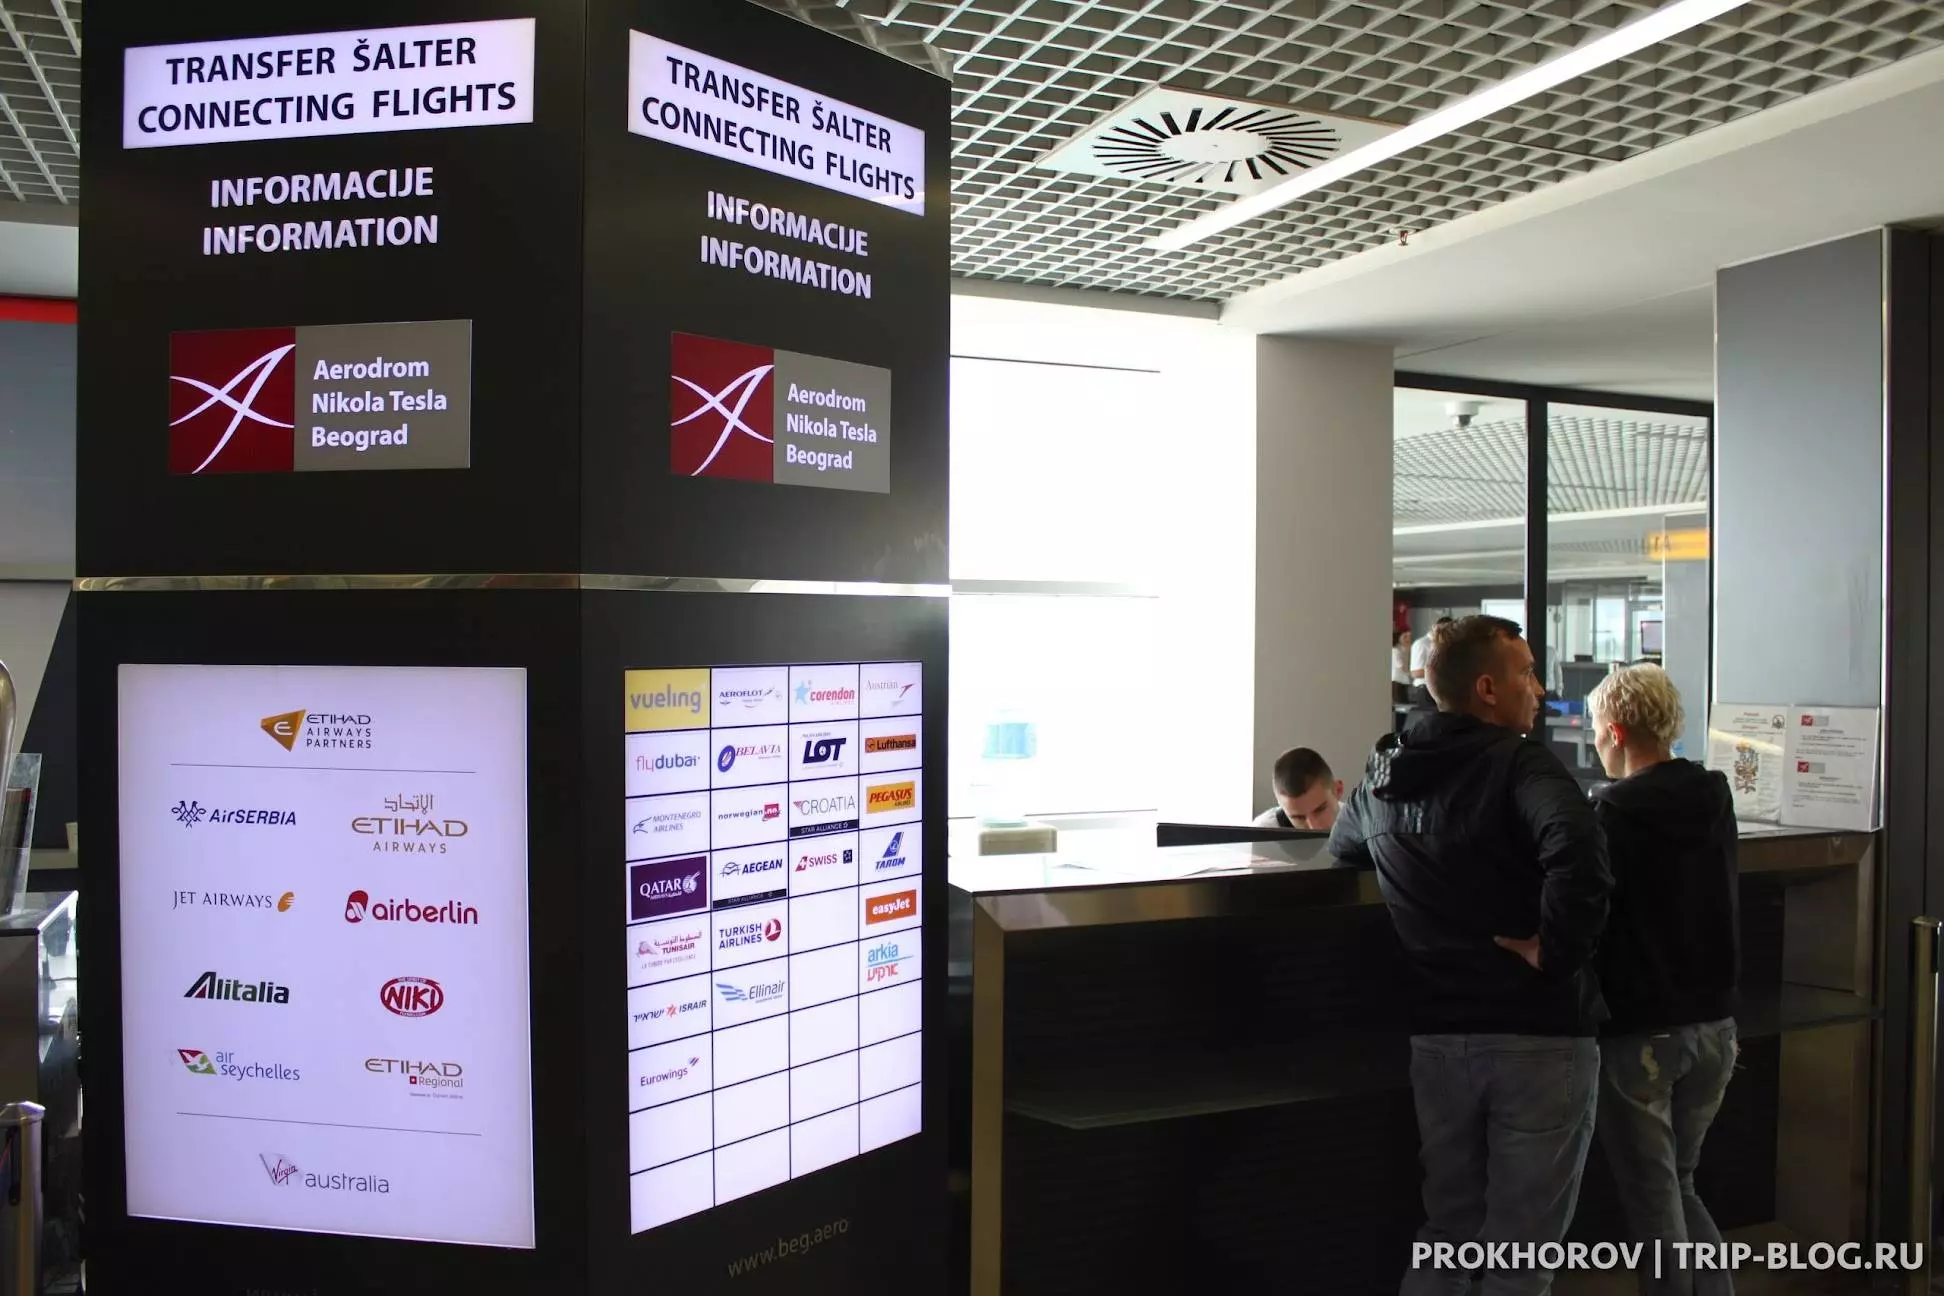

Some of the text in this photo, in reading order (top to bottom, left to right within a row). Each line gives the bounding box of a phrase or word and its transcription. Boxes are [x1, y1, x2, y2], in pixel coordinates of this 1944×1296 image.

[166, 37, 476, 85] TRANSFER ŠALTER
[138, 82, 516, 133] CONNECTING FLIGHTS
[667, 56, 891, 152] TRANSFER ŠALTER
[643, 97, 914, 199] CONNECTING FLIGHTS
[211, 167, 434, 208] INFORMACIJE
[708, 191, 868, 256] INFORMACIJE
[203, 215, 438, 255] INFORMATION
[701, 236, 871, 298] INFORMATION
[313, 358, 429, 380] Aerodrom
[312, 390, 447, 414] Nikola Tesla
[788, 383, 866, 412] Aerodrom
[312, 425, 407, 451] Beograd
[787, 414, 877, 443] Nikola Tesla
[787, 445, 853, 470] Beograd
[719, 690, 762, 698] AEROFLOT
[810, 687, 855, 702] corendon
[866, 680, 898, 690] Austrian
[631, 684, 701, 713] vueling
[306, 713, 371, 725] ETIHAD
[306, 727, 371, 737] AIRWAYS
[306, 738, 371, 749] PARTNERS
[736, 744, 781, 756] BELAVIA
[803, 738, 846, 764] LOT
[877, 738, 916, 750] Lufthansa
[636, 754, 698, 772] flydubai
[869, 788, 912, 803] PEGASUS
[801, 796, 855, 815] CROATIA
[653, 811, 701, 822] MONTENEGRO
[352, 817, 468, 837] ETIHAD
[653, 823, 683, 833] AIRLINES
[801, 823, 841, 834] STAR ALLIANCE
[373, 841, 446, 853] AIRWAYS
[742, 858, 783, 874] AEGEAN
[809, 853, 837, 867] SWISS
[876, 857, 905, 870] TAROM
[640, 878, 681, 898] QATAR
[173, 891, 272, 909] JET AIRWAYS
[873, 898, 910, 915] easyJet
[372, 898, 478, 924] airberlin
[720, 923, 762, 938] TURKISH
[662, 943, 694, 954] TUNISAIR
[719, 934, 762, 949] AIRLINES
[868, 942, 898, 962] arkia
[184, 972, 289, 1004] Alitalia
[387, 985, 436, 1010] NIKI
[749, 980, 785, 999] Ellinair
[679, 1000, 707, 1013] ISRAIR
[216, 1050, 234, 1063] air
[221, 1062, 300, 1081] seychelles
[365, 1059, 462, 1076] ETIHAD
[640, 1067, 688, 1087] Eurowings
[419, 1077, 463, 1088] Regional
[272, 1159, 389, 1193] Virgin australia
[728, 1217, 849, 1278] www.beg.aero
